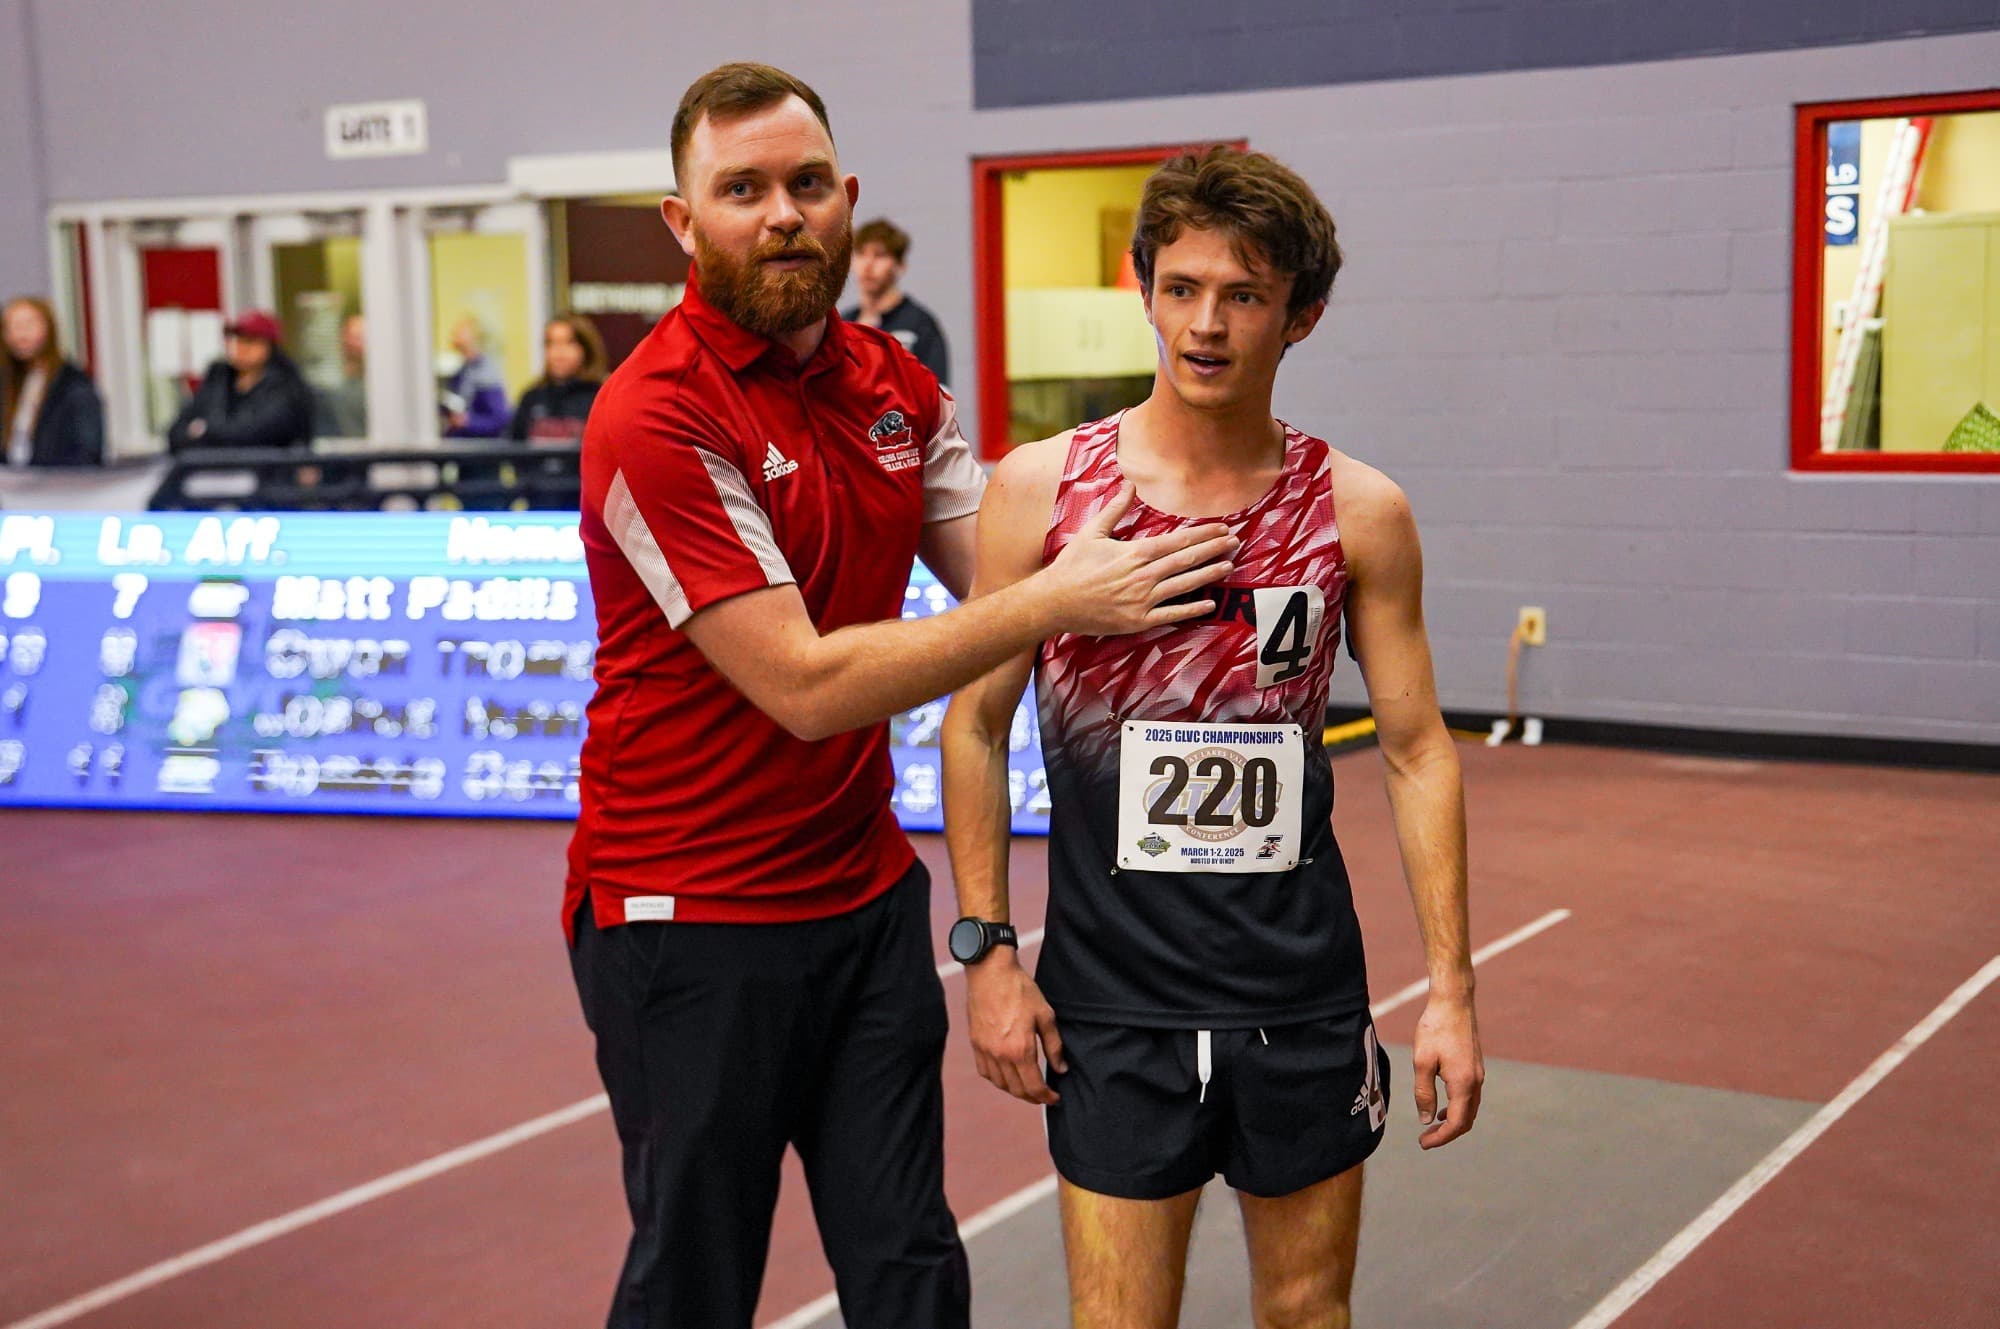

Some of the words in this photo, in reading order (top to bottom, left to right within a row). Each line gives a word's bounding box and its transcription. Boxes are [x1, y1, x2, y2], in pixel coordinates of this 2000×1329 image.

[763, 458, 799, 482] adidas
[112, 573, 148, 619] 7
[1260, 590, 1311, 683] 4
[1145, 728, 1172, 742] 2025
[1175, 729, 1200, 743] GLVC
[1202, 730, 1284, 744] CHAMPIONSHIPS
[1148, 755, 1277, 828] 220
[1181, 847, 1208, 857] MARCH
[1225, 847, 1245, 857] 2025
